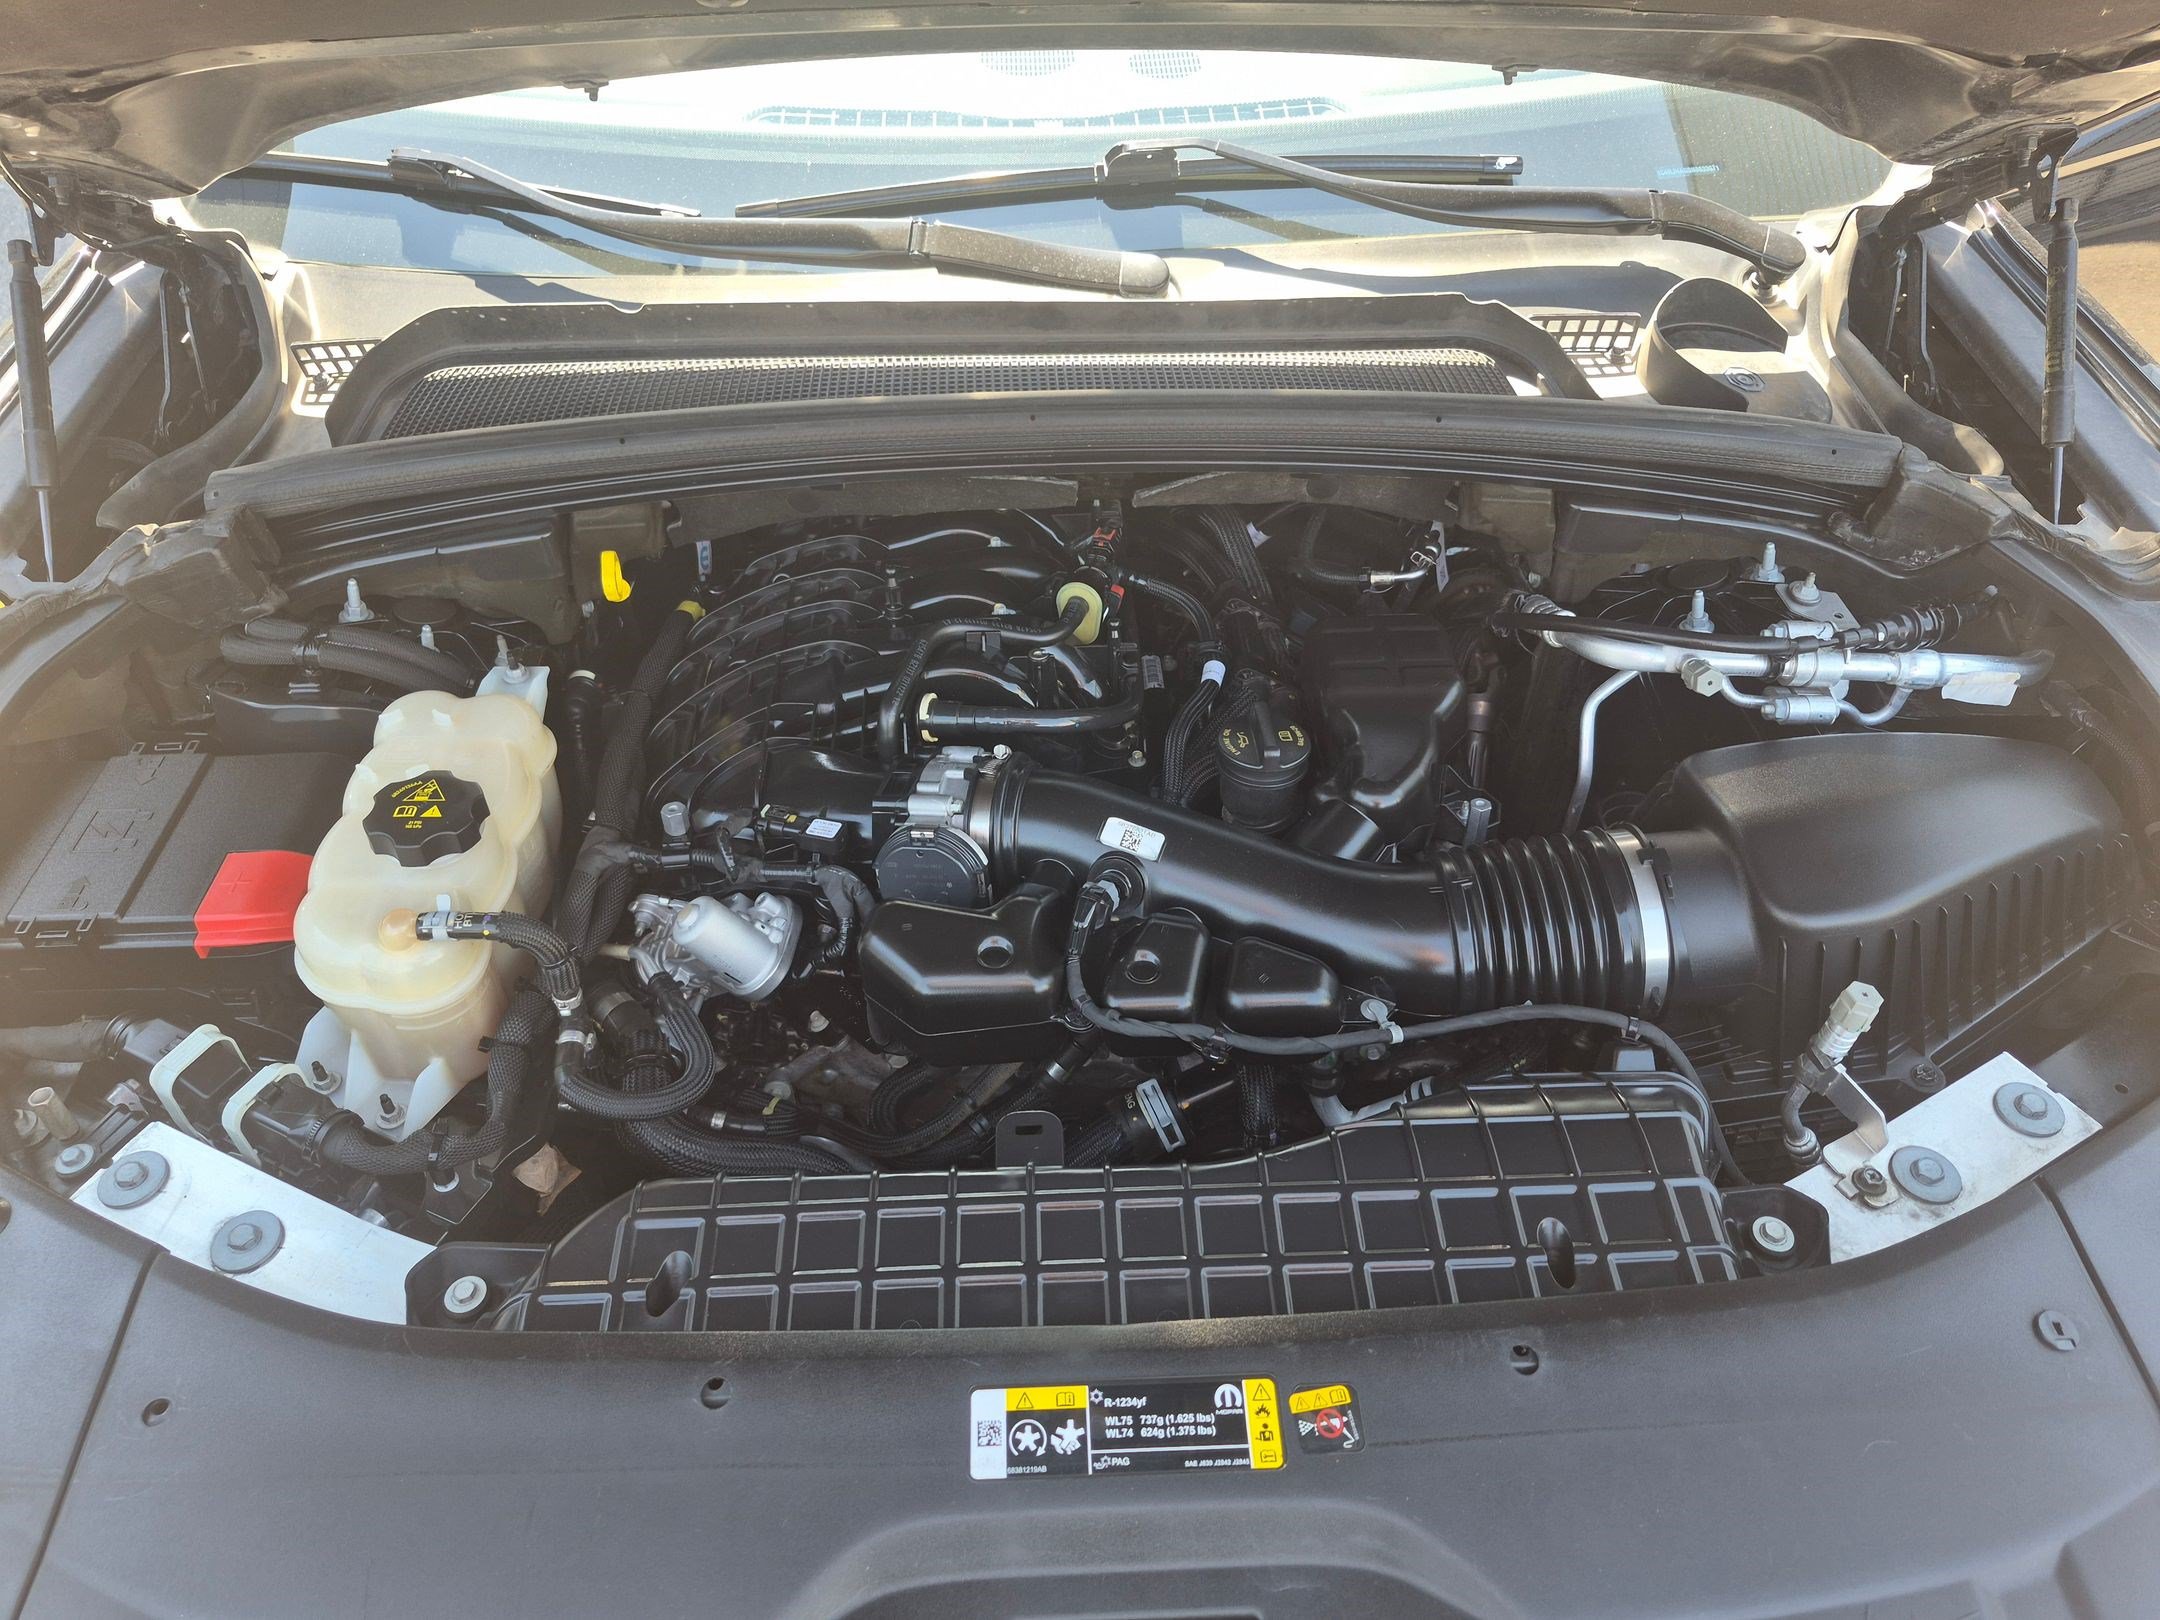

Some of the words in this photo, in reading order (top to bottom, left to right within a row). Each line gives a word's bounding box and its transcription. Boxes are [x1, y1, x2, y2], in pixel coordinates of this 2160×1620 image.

[1104, 1397, 1147, 1408] R-1234yf
[1105, 1416, 1133, 1426] WL75
[1140, 1414, 1164, 1426] 737g
[1166, 1414, 1195, 1425] (1.625
[1196, 1413, 1215, 1424] lbs)
[1106, 1428, 1134, 1438] WL74
[1140, 1427, 1164, 1438] 624g
[1166, 1426, 1196, 1437] (1.375
[1197, 1425, 1216, 1436] lbs)
[1111, 1456, 1130, 1466] PAG
